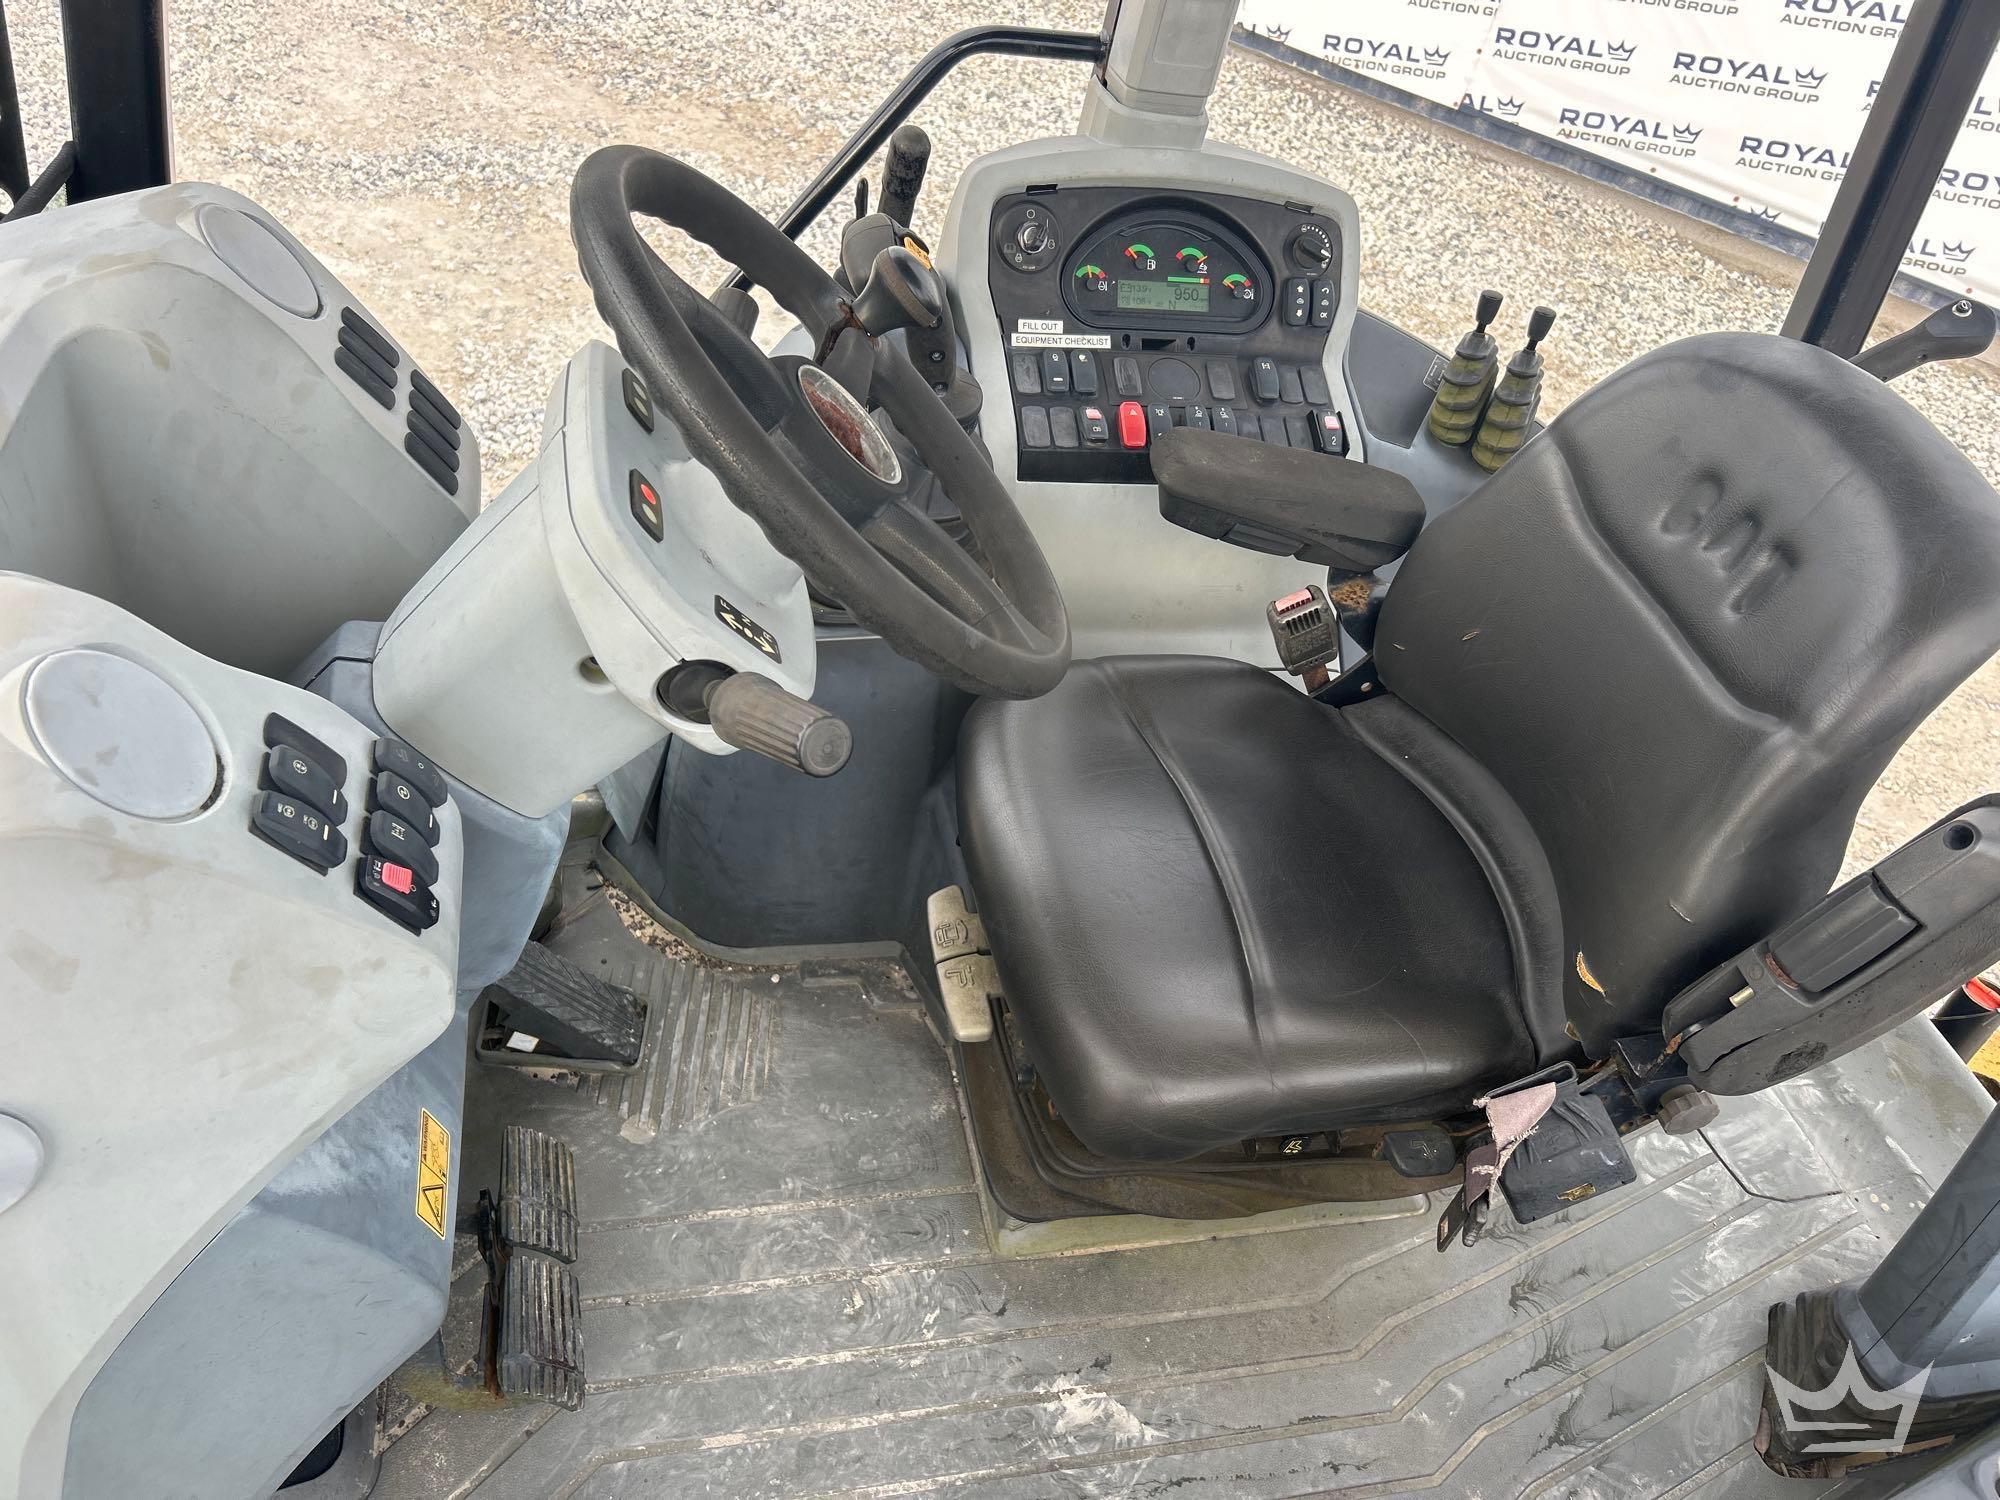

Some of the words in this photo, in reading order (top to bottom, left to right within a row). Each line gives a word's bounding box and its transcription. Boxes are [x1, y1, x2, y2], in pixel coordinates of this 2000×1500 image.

[1674, 0, 1739, 15] GROUP
[1780, 13, 1867, 34] AUCTION
[1323, 34, 1420, 63] ROYAL
[1495, 27, 1603, 58] ROYAL
[1391, 64, 1446, 79] GROUP
[1492, 48, 1567, 67] AUCTION
[1570, 59, 1631, 75] GROUP
[1673, 51, 1790, 85] ROYAL
[1669, 73, 1751, 94] AUCTION
[1753, 86, 1820, 104] GROUP
[1559, 107, 1668, 140] ROYAL
[1556, 127, 1632, 148] AUCTION
[1634, 140, 1697, 157] GROUP
[1735, 156, 1818, 178] AUCTION
[1174, 287, 1199, 301] 950
[1168, 300, 1177, 310] N
[1022, 322, 1039, 331] FILL
[1040, 322, 1059, 331] OUT
[1015, 336, 1062, 345] EQUIPMENT
[1064, 337, 1108, 346] CHECKLIST
[1331, 436, 1337, 446] 2
[720, 599, 730, 611] F
